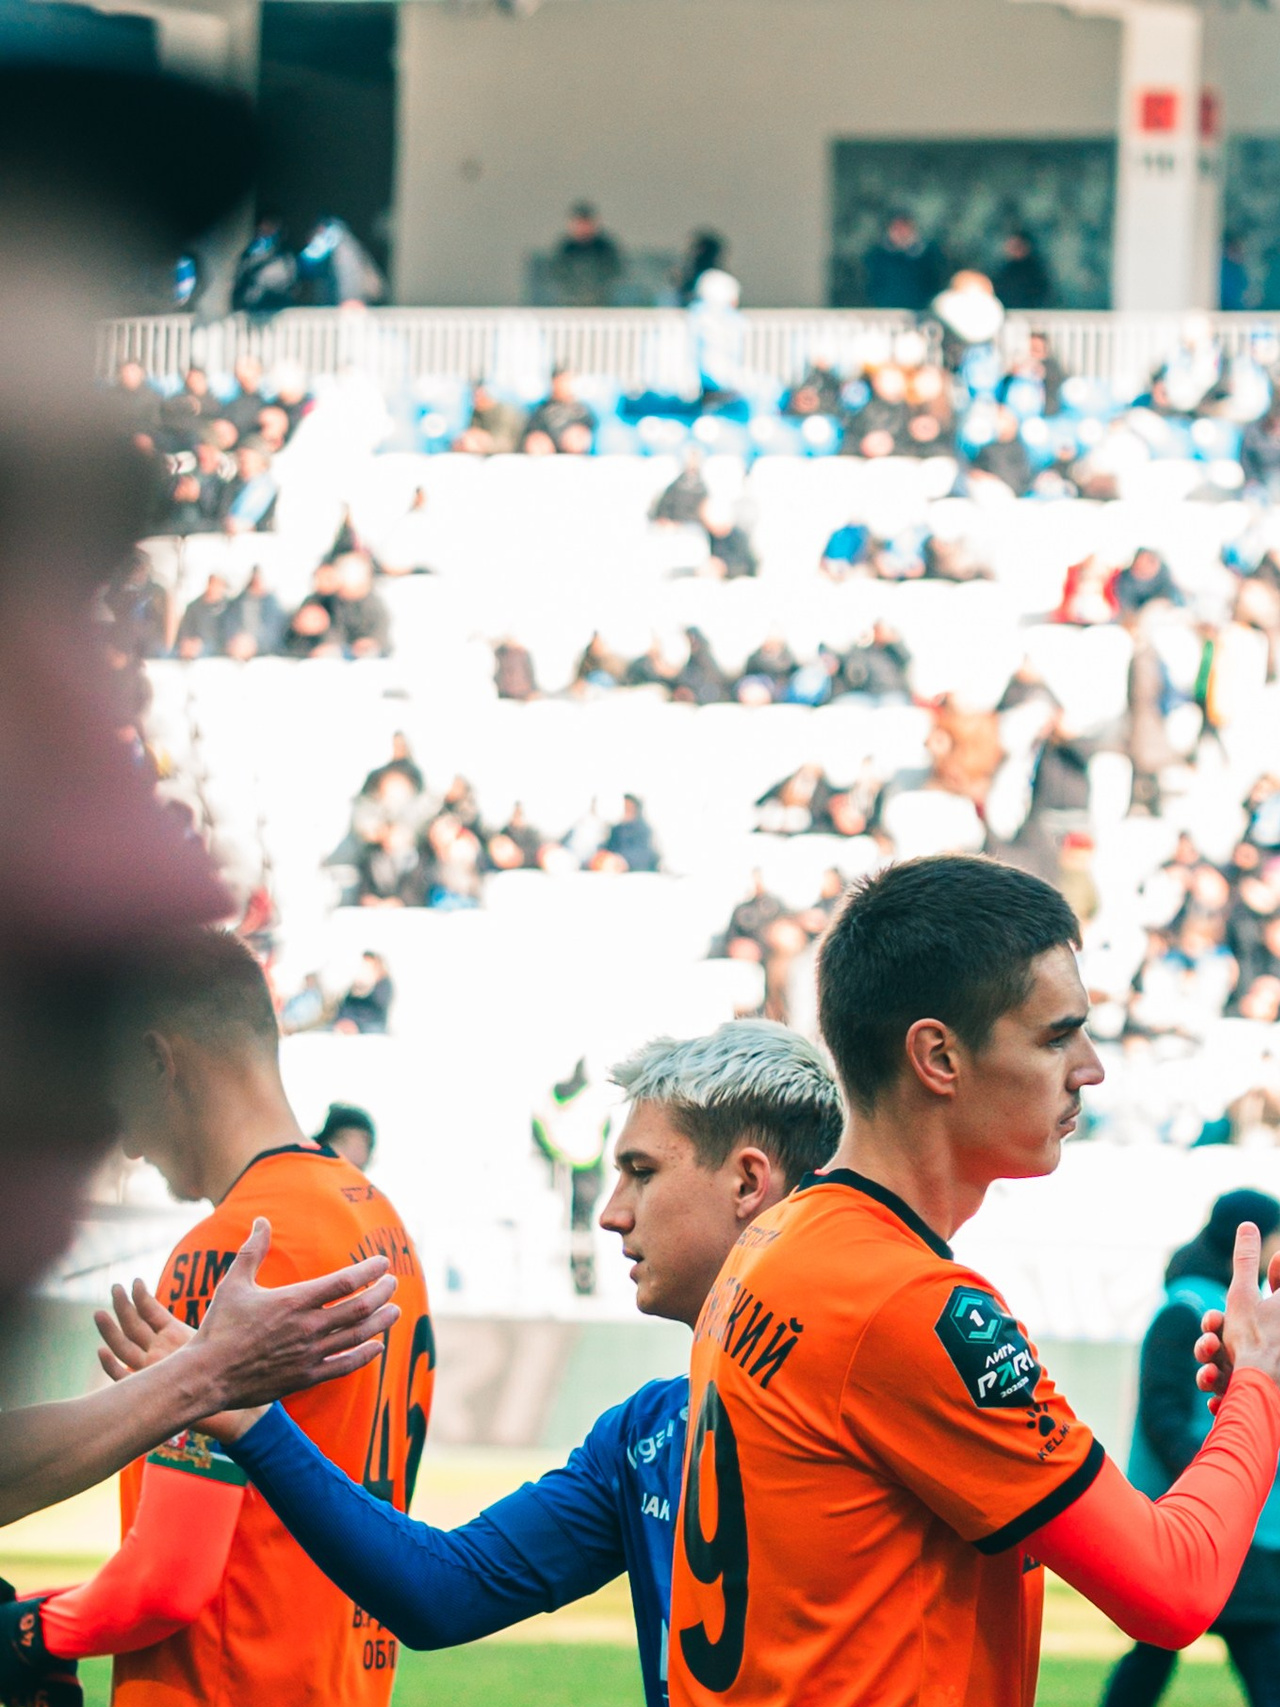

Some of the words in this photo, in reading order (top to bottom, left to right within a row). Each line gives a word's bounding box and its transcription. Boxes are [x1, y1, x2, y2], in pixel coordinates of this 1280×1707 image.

[170, 1249, 238, 1300] SIM
[985, 1343, 1017, 1369] ЛИГА
[641, 1492, 671, 1521] JAK
